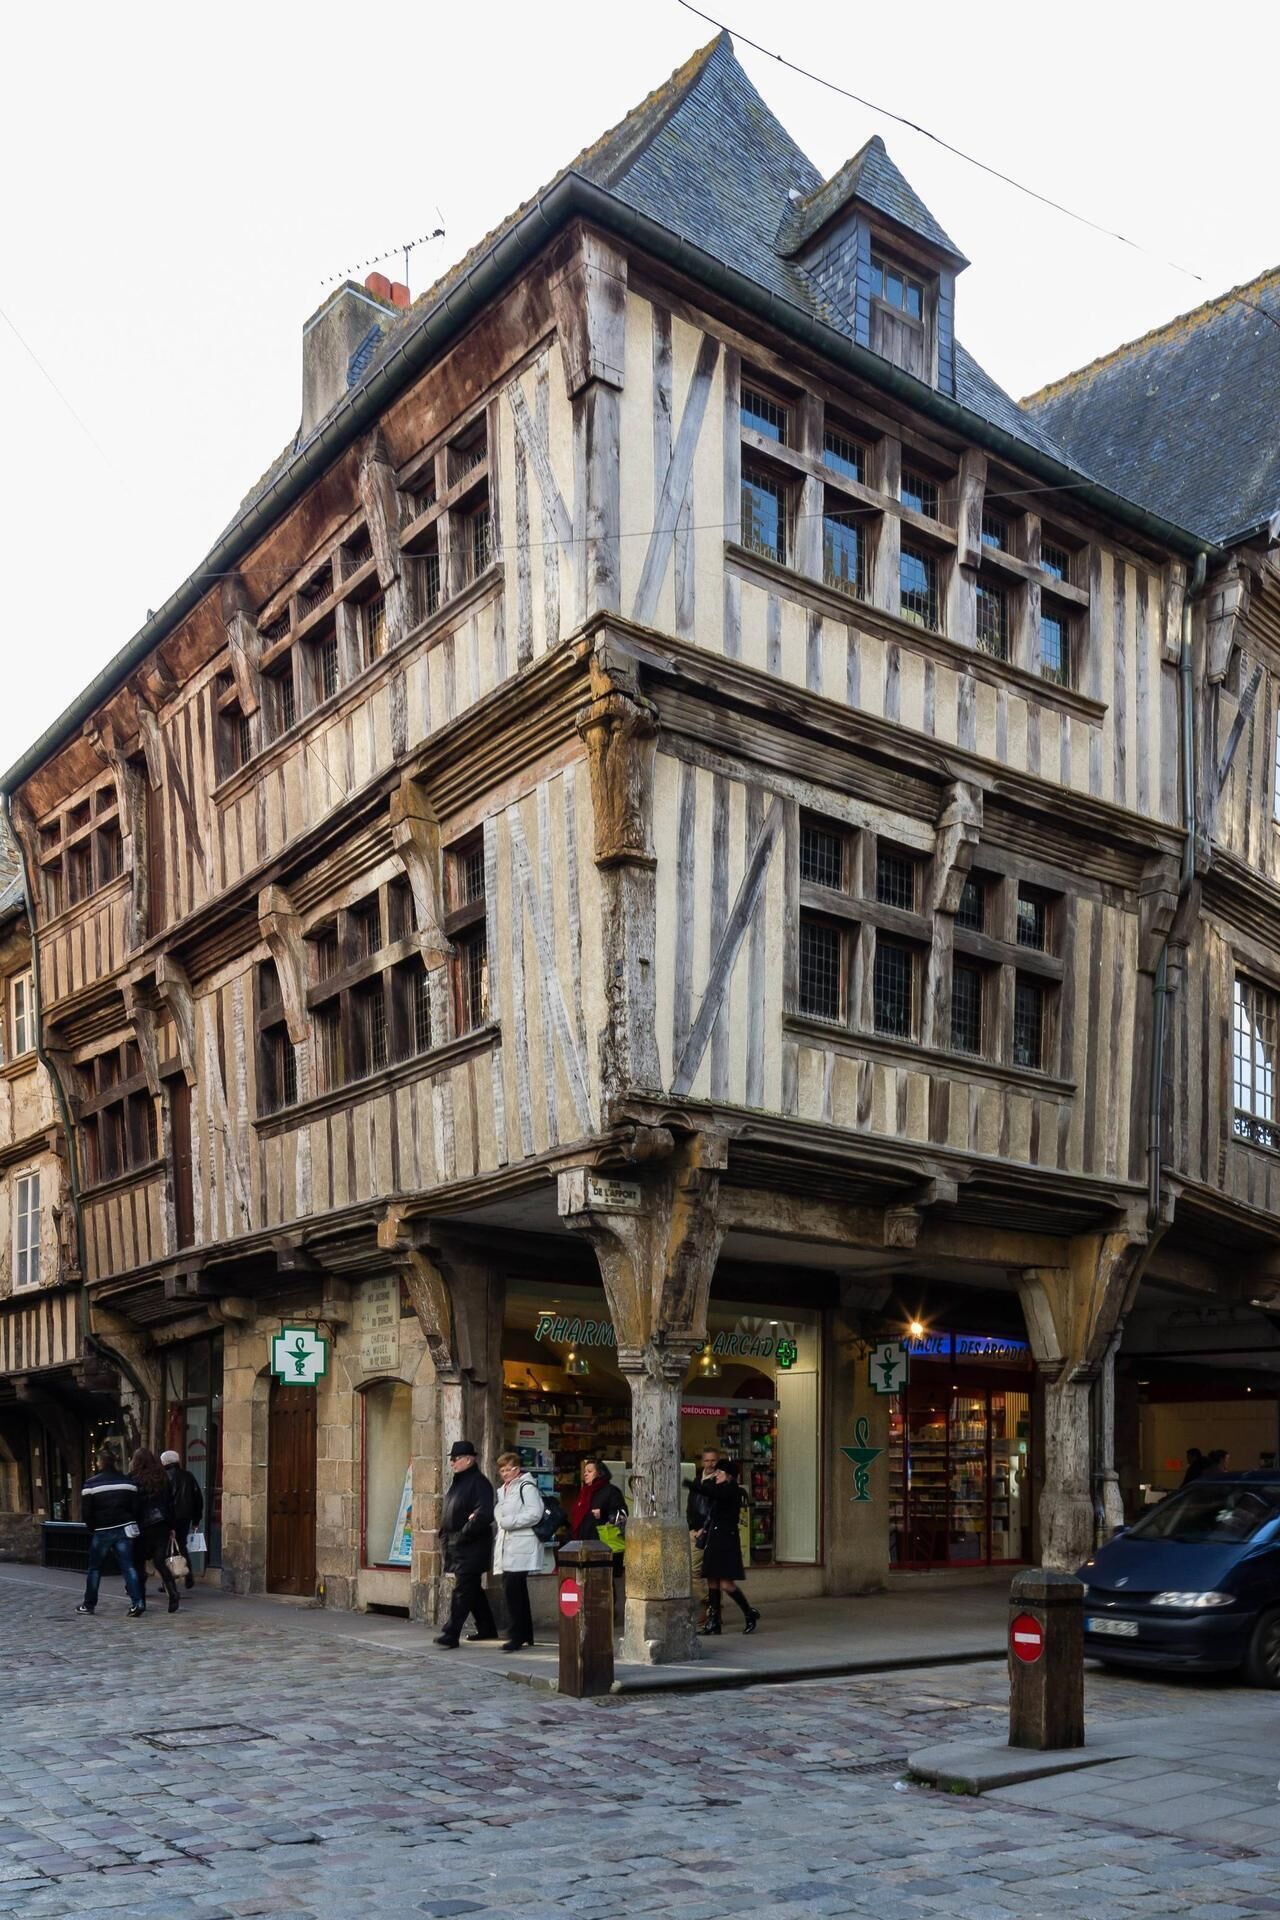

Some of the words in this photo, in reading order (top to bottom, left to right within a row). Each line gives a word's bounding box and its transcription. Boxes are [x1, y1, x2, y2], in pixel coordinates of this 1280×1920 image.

[593, 1187, 602, 1196] DE
[535, 1316, 618, 1347] PHARM
[713, 1331, 796, 1359] ARCADES
